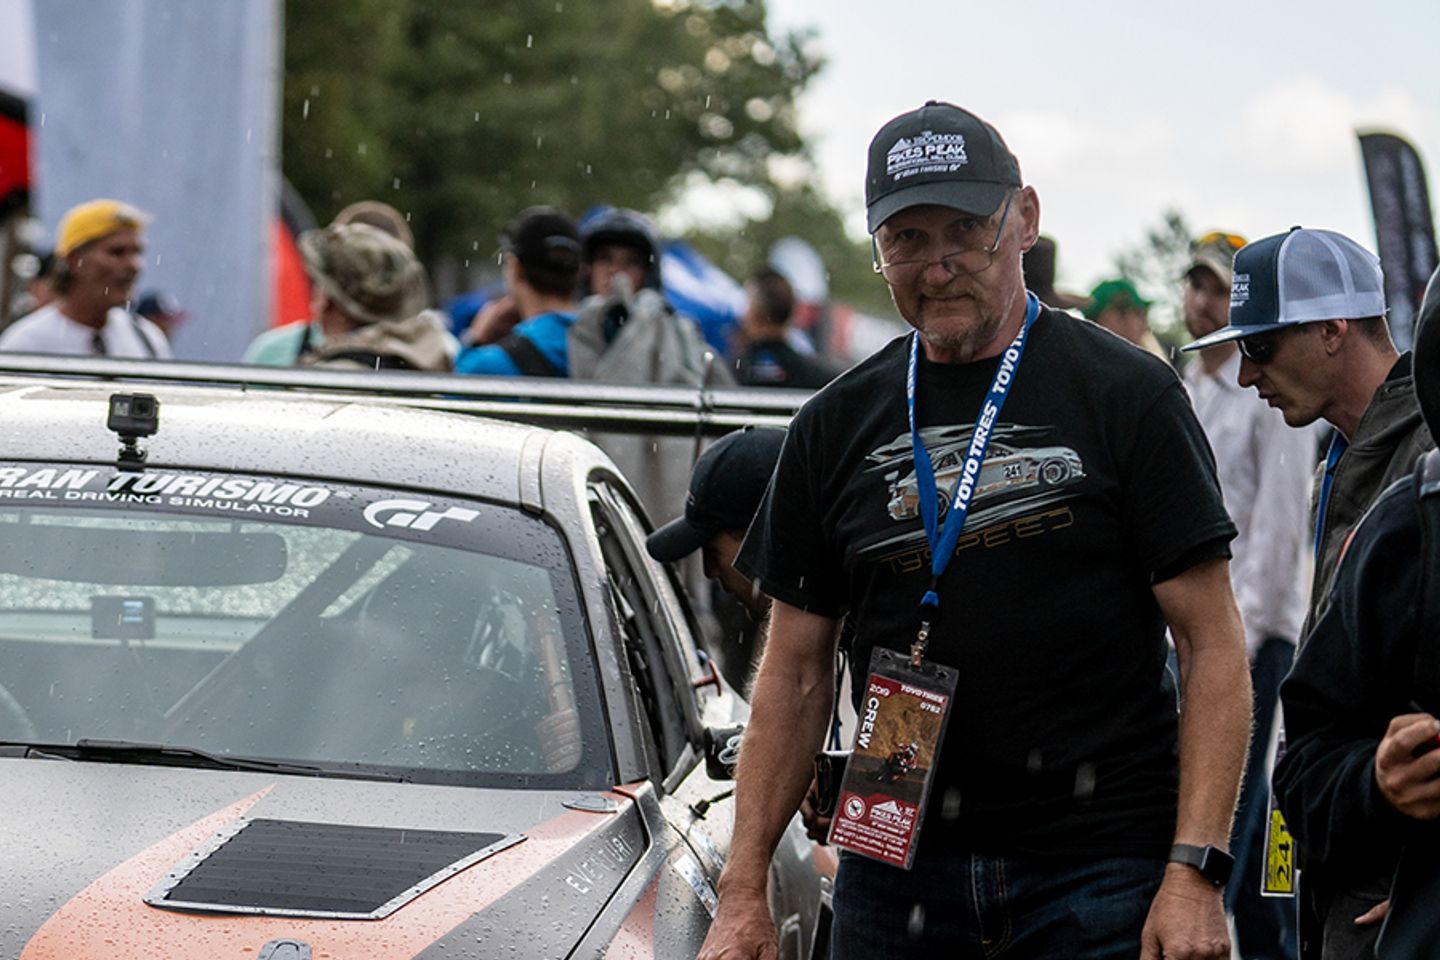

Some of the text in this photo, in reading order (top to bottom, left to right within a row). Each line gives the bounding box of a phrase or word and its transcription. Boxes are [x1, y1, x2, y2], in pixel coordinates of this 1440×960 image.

[887, 144, 966, 166] PIKES PEAK
[991, 348, 1022, 394] TOYO
[954, 400, 998, 511] TOYO TIRES
[65, 489, 162, 505] DRIVING
[168, 496, 310, 519] SIMULATOR
[107, 471, 331, 507] TURISMO
[858, 697, 880, 750] CREW
